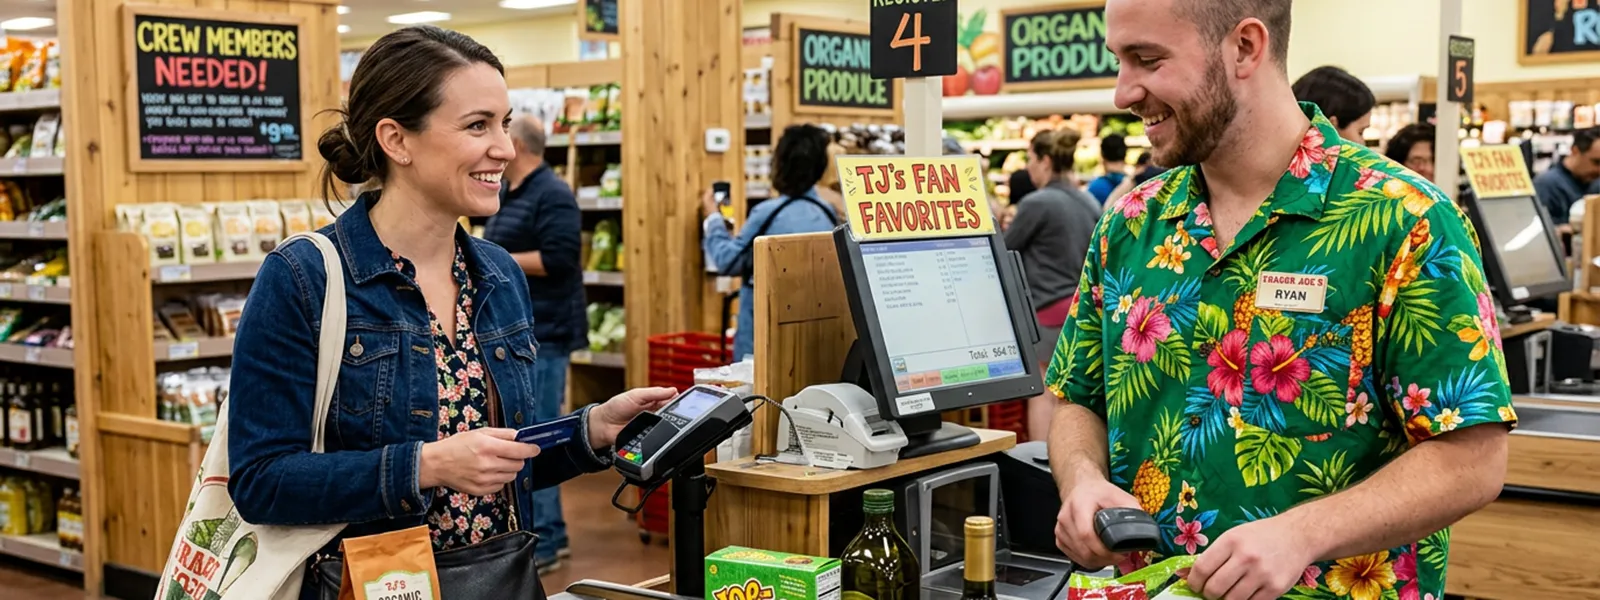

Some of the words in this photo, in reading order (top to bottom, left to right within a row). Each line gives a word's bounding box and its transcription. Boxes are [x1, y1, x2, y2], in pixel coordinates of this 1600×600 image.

[137, 20, 201, 54] CREW
[206, 26, 297, 61] MEMBERS
[890, 12, 931, 72] 4
[1011, 11, 1107, 46] ORGAN
[1573, 8, 1600, 46] R
[804, 34, 870, 69] ORGANI
[1011, 41, 1120, 78] PRODU
[155, 56, 268, 91] NEEDED!
[803, 68, 888, 104] PRODUCE
[1455, 60, 1467, 98] 5
[855, 163, 907, 194] TJ's
[912, 163, 961, 194] FAN
[858, 198, 981, 234] FAVORITES
[1275, 289, 1307, 301] RYAN
